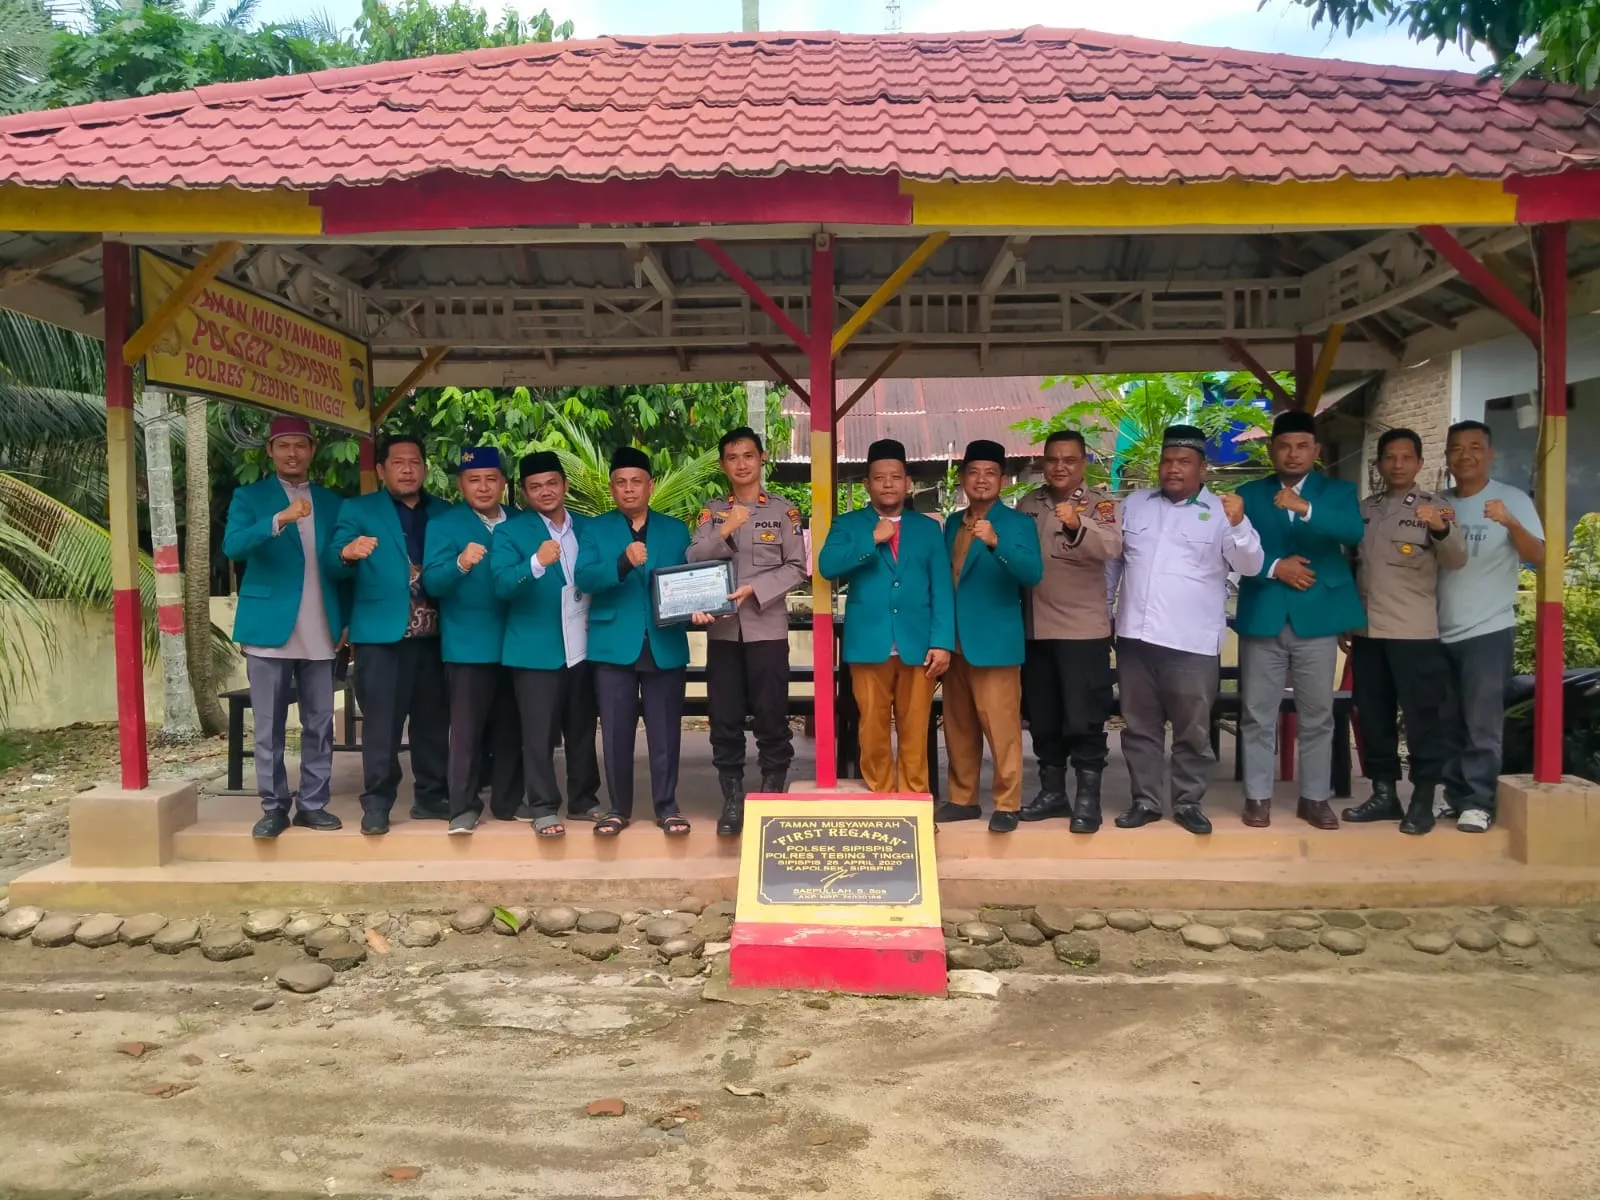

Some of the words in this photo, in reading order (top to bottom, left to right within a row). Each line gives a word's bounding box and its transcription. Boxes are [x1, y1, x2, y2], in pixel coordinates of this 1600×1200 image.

[191, 318, 276, 368] POLSEK
[275, 347, 343, 393] SIPISPIS
[251, 306, 342, 361] MUSYAWARAH
[184, 351, 247, 389] POLRES
[250, 371, 300, 405] TEBING
[302, 387, 347, 419] TINGGI
[754, 521, 782, 529] POLRI
[765, 852, 815, 860] POLRES
[820, 852, 866, 860] TEBING
[871, 852, 914, 860] TINGGI
